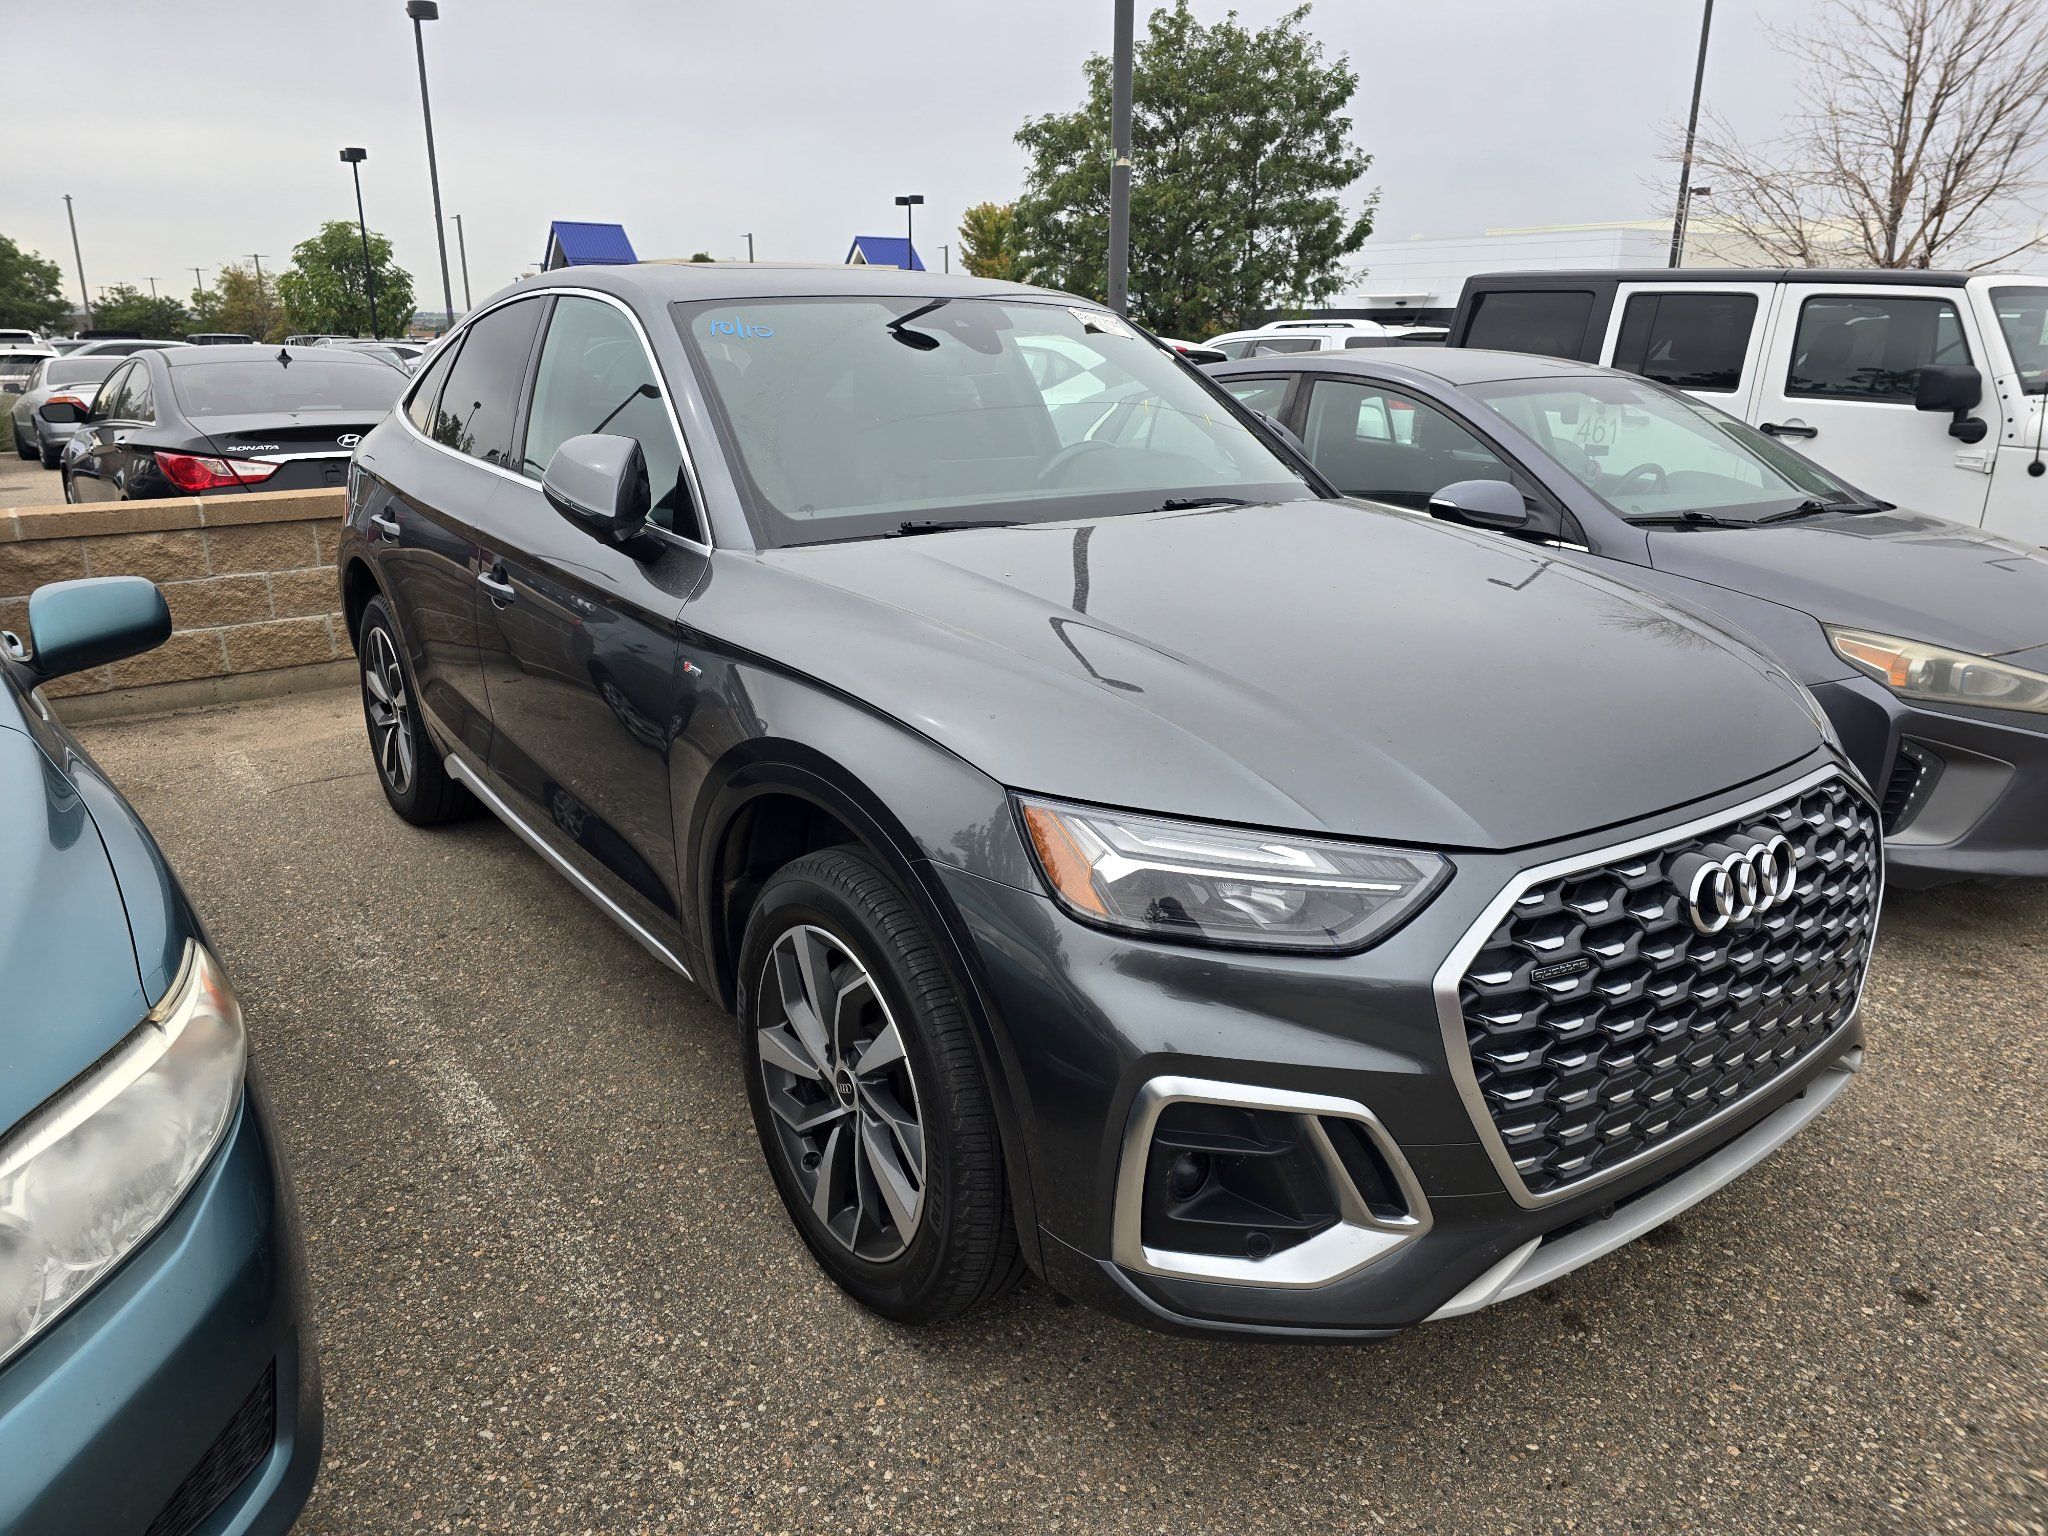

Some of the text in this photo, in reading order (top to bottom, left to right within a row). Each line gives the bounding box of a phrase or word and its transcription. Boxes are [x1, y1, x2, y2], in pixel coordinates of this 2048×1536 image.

[710, 315, 775, 340] 10/10
[1577, 416, 1617, 445] 461
[226, 444, 280, 452] SONATA
